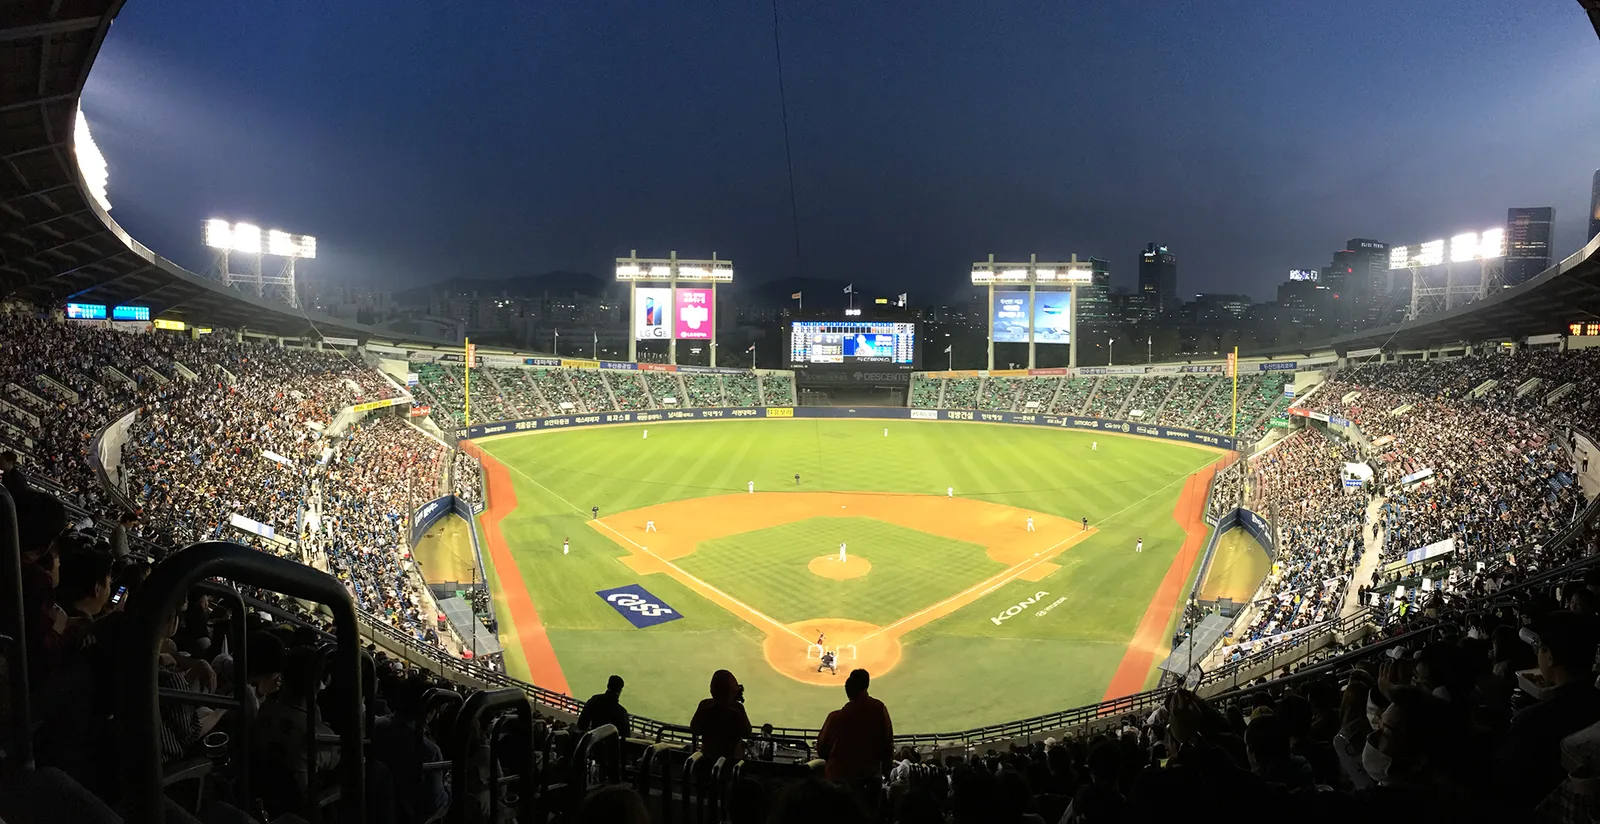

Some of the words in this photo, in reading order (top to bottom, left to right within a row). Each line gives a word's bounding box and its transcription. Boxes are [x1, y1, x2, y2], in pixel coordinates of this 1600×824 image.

[865, 372, 909, 381] DESCENTE
[947, 411, 974, 420] 대방건설
[990, 590, 1050, 626] KONA
